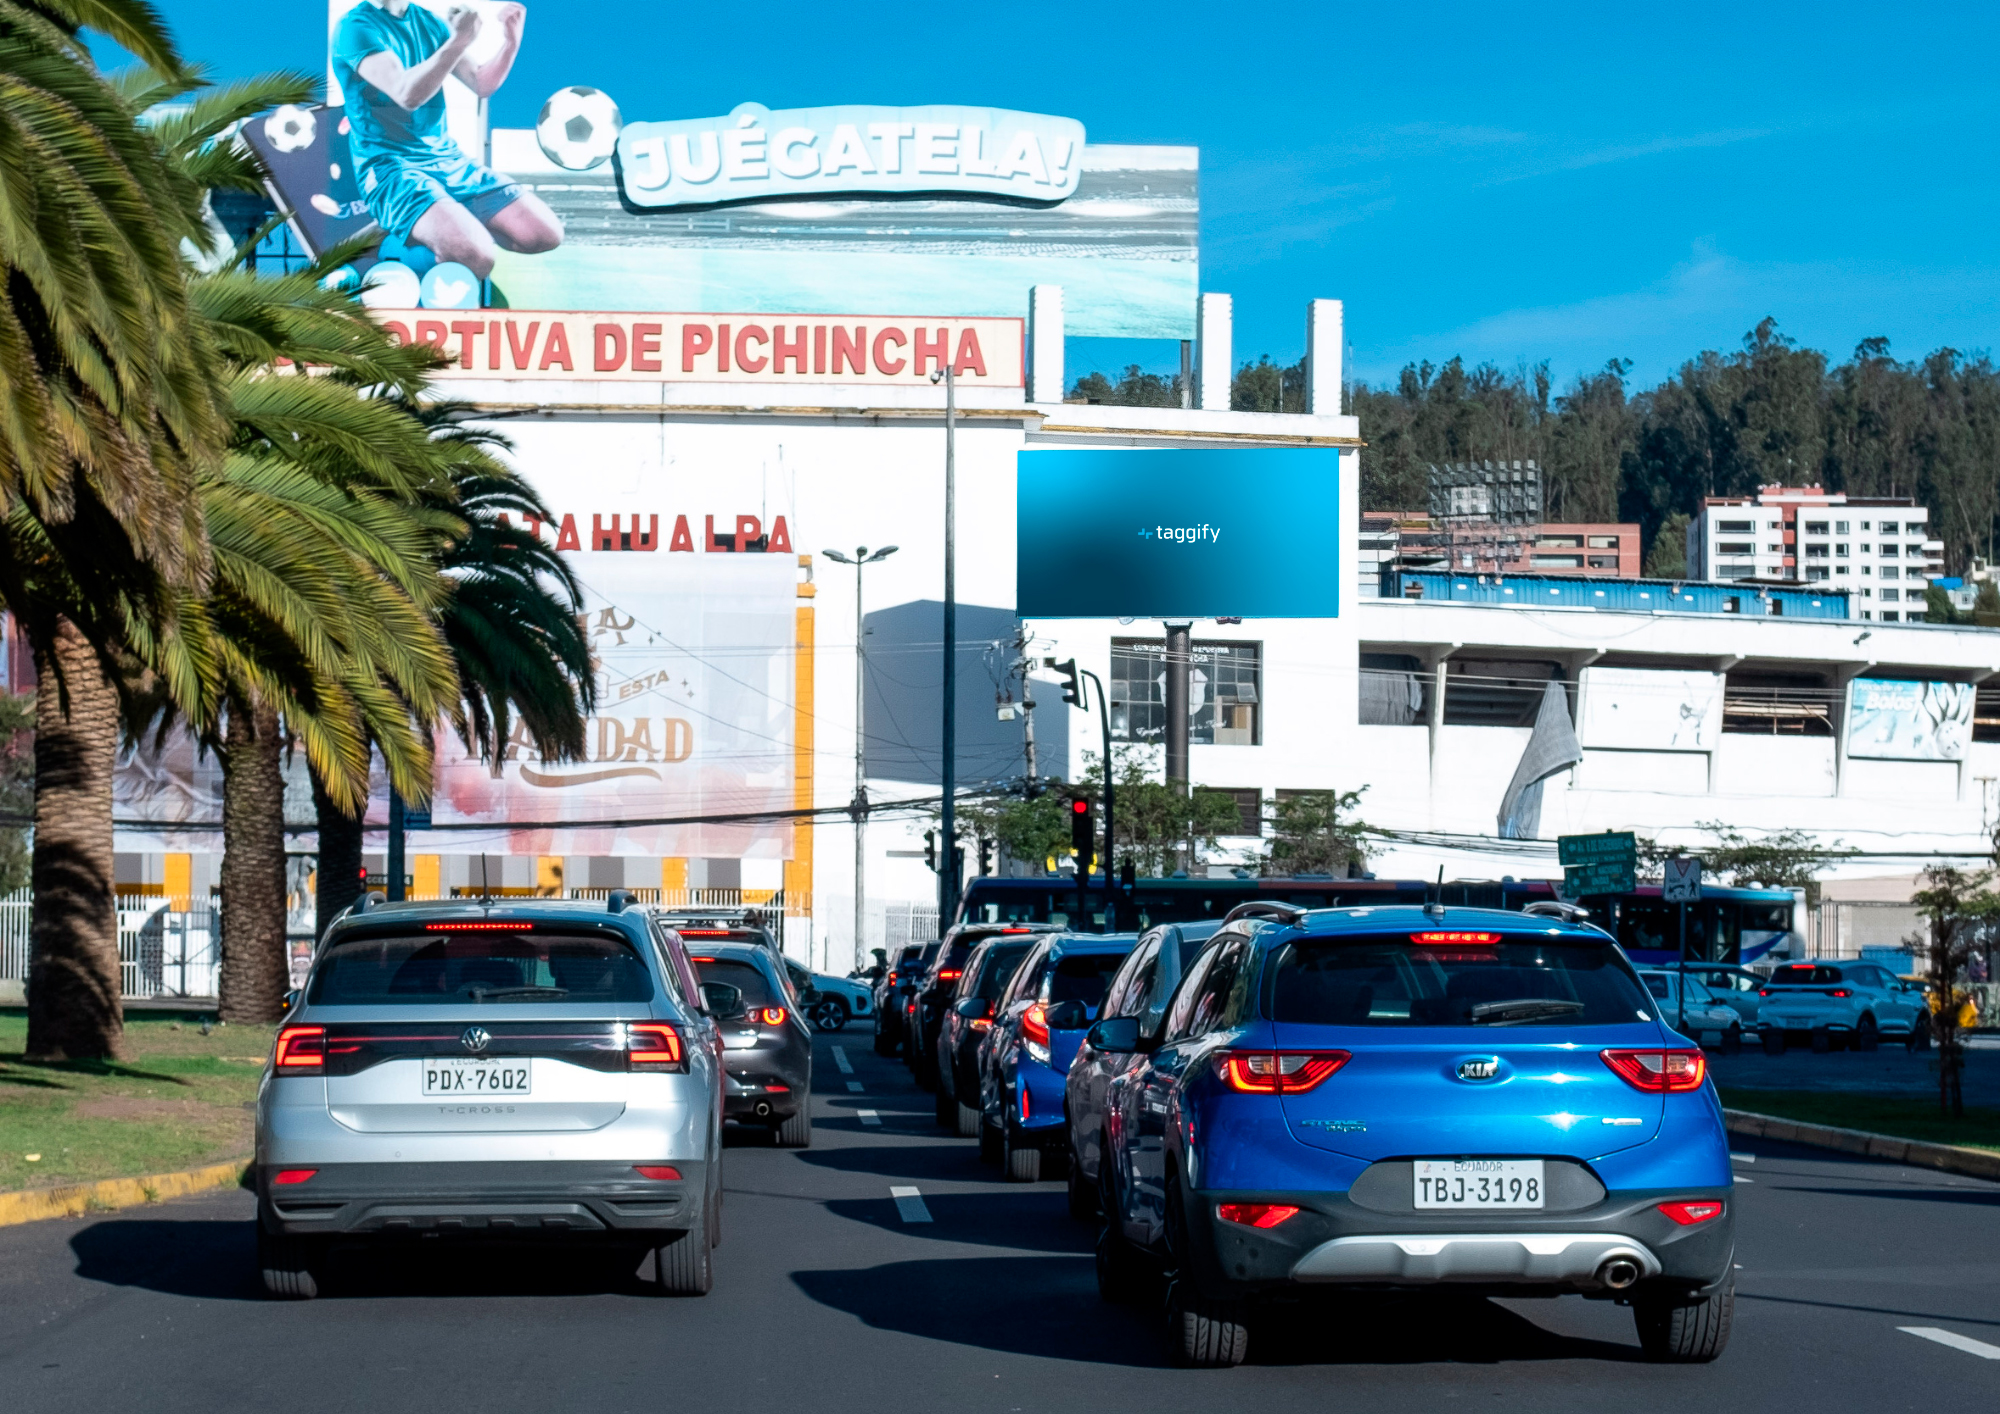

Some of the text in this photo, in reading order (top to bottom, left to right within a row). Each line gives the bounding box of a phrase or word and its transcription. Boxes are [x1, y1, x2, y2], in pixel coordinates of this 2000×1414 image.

[631, 114, 1074, 189] JUÉGATELA!
[594, 323, 663, 372] DE
[682, 324, 987, 377] PICHINCHA
[1156, 523, 1221, 543] taggify
[619, 669, 670, 700] ESTA
[1865, 690, 1915, 712] Bolos
[427, 1069, 527, 1090] PDX-7602
[1464, 1062, 1495, 1077] KIA
[438, 1106, 516, 1114] T-CROSS
[1454, 1161, 1503, 1172] ECUADOR
[1419, 1177, 1539, 1202] TBJ-3198
